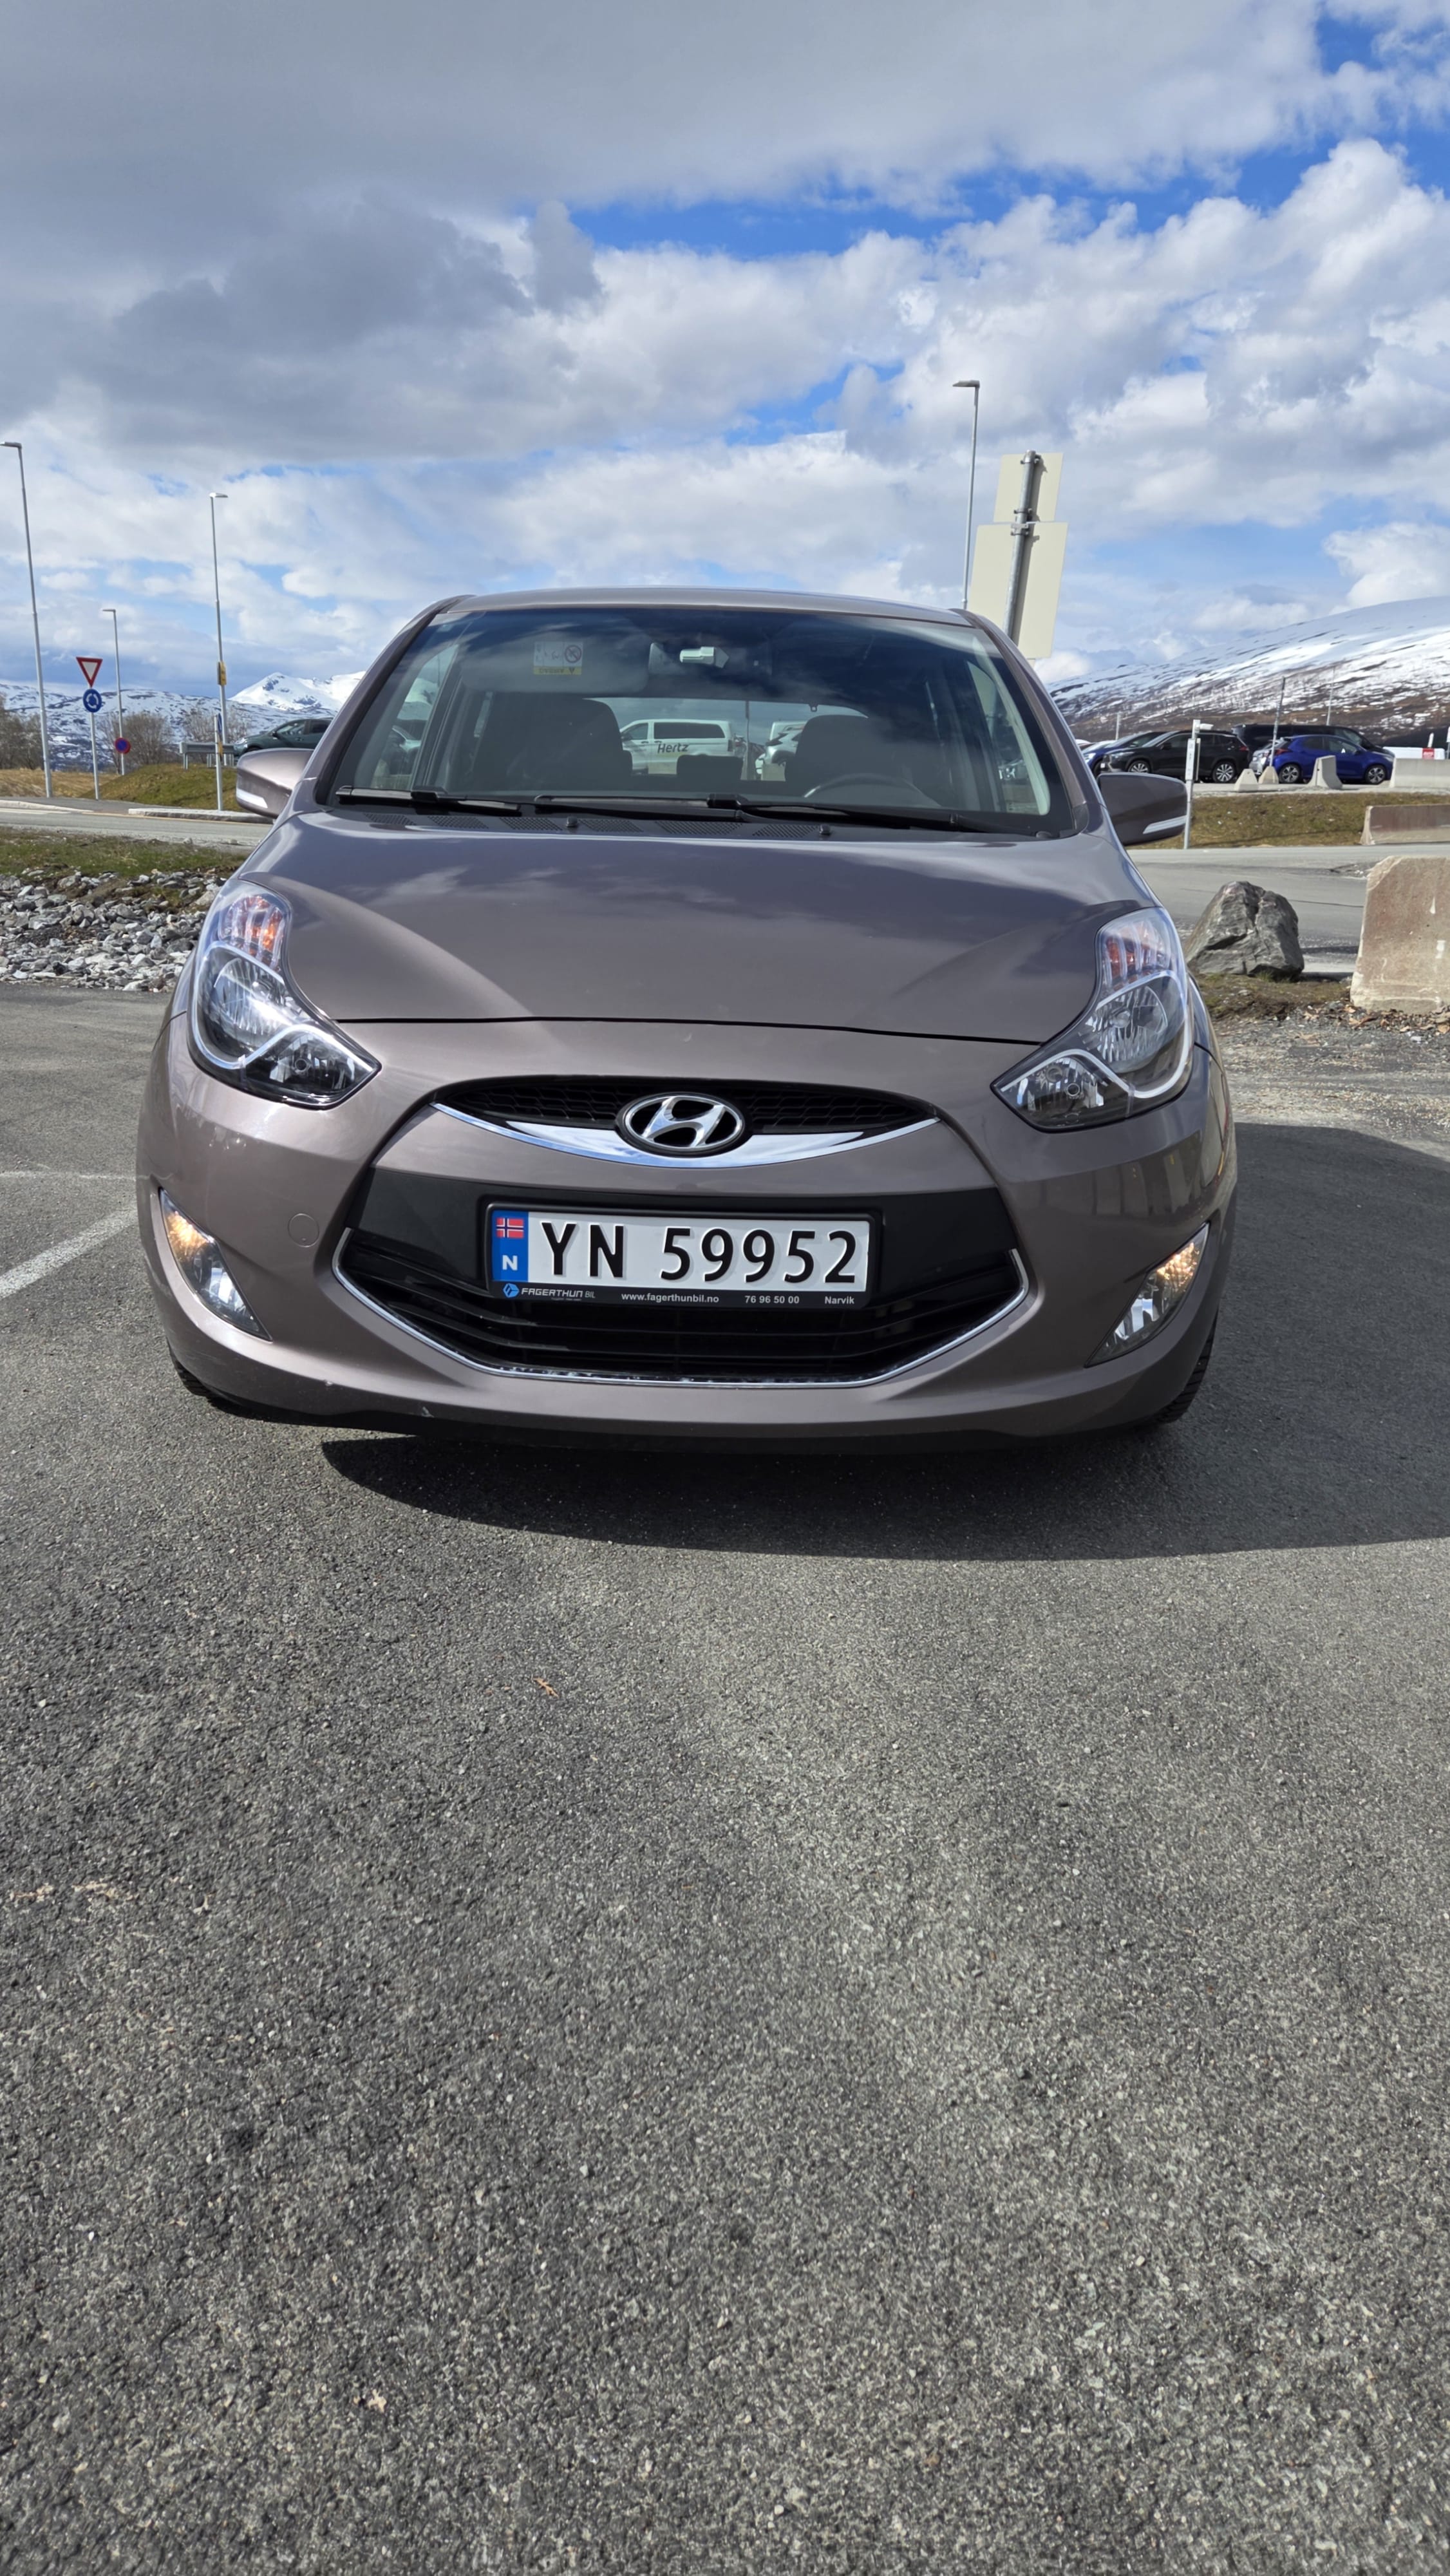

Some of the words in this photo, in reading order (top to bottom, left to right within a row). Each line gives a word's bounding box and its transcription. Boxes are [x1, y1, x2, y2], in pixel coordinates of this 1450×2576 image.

[657, 743, 689, 753] Hertz
[540, 1221, 624, 1278] YN
[661, 1227, 856, 1283] 59952
[502, 1255, 518, 1271] N
[521, 1288, 583, 1298] FAGERTHUN
[621, 1293, 719, 1303] www.fagerthunbil.no
[825, 1296, 854, 1304] Narvik
